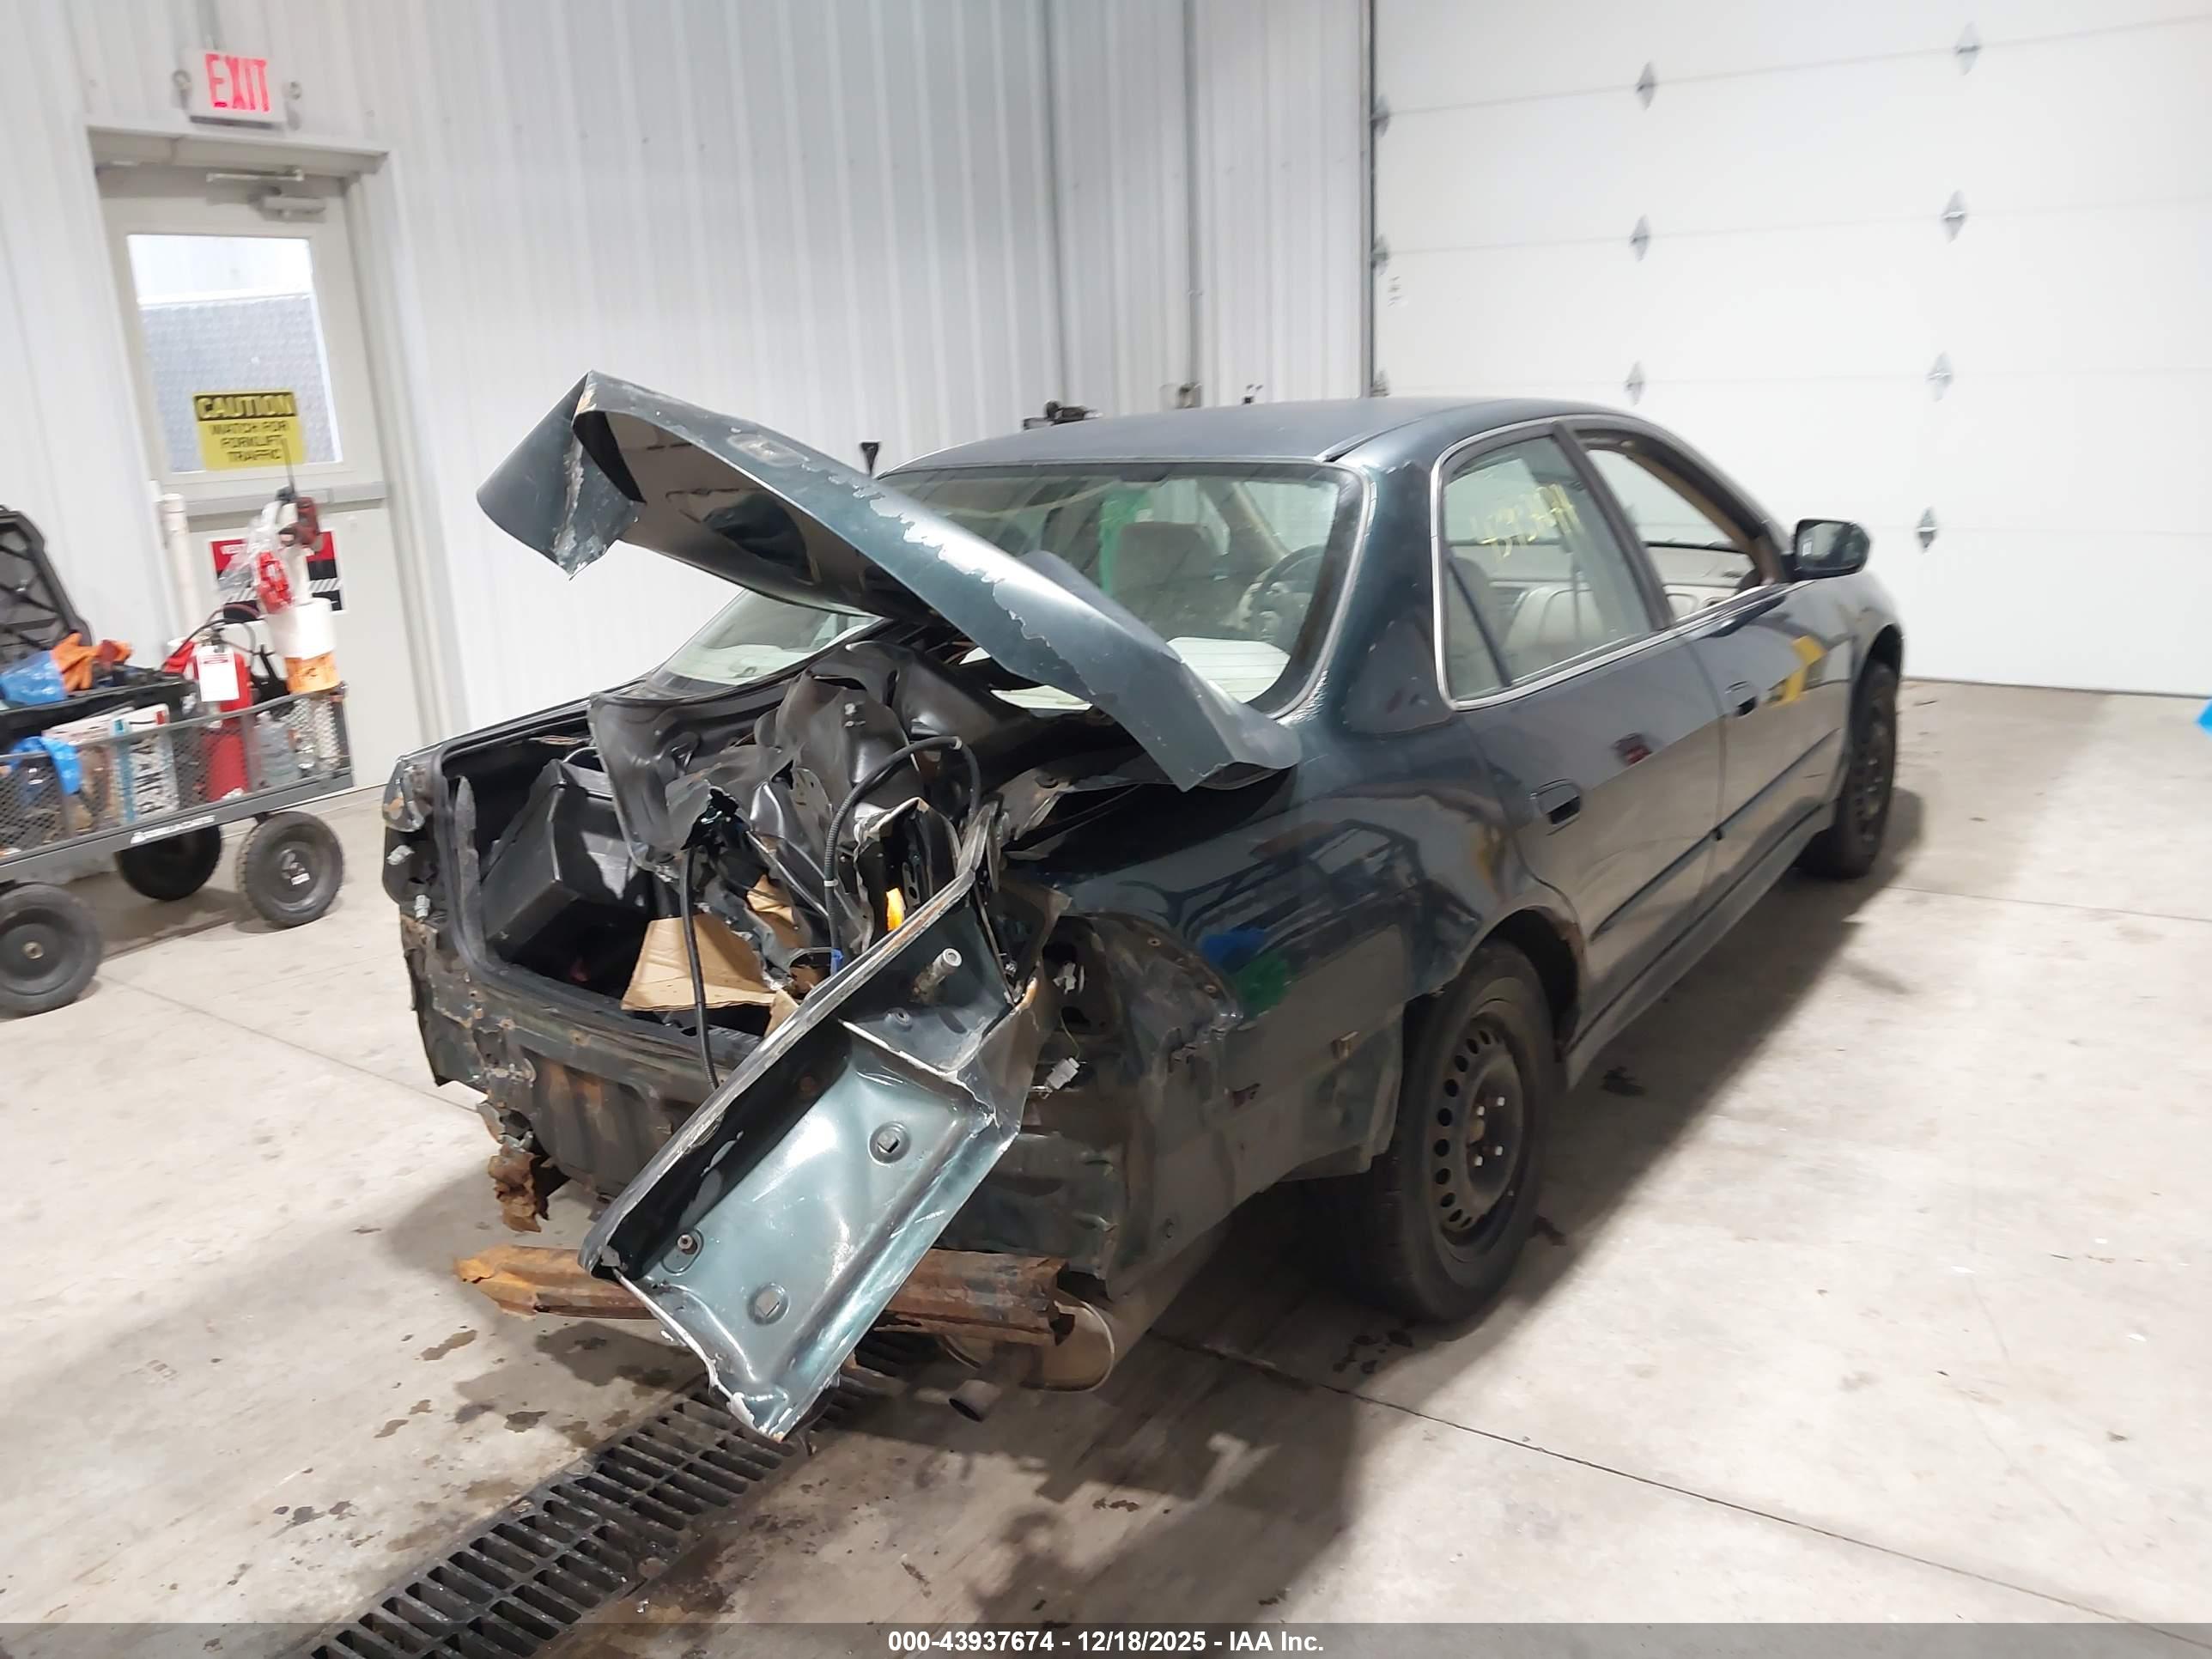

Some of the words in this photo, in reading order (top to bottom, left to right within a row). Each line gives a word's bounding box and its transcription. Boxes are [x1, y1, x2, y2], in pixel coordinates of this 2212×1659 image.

[205, 53, 270, 112] EXIT
[197, 394, 294, 419] CAUTION
[227, 449, 282, 461] TRAFFIC
